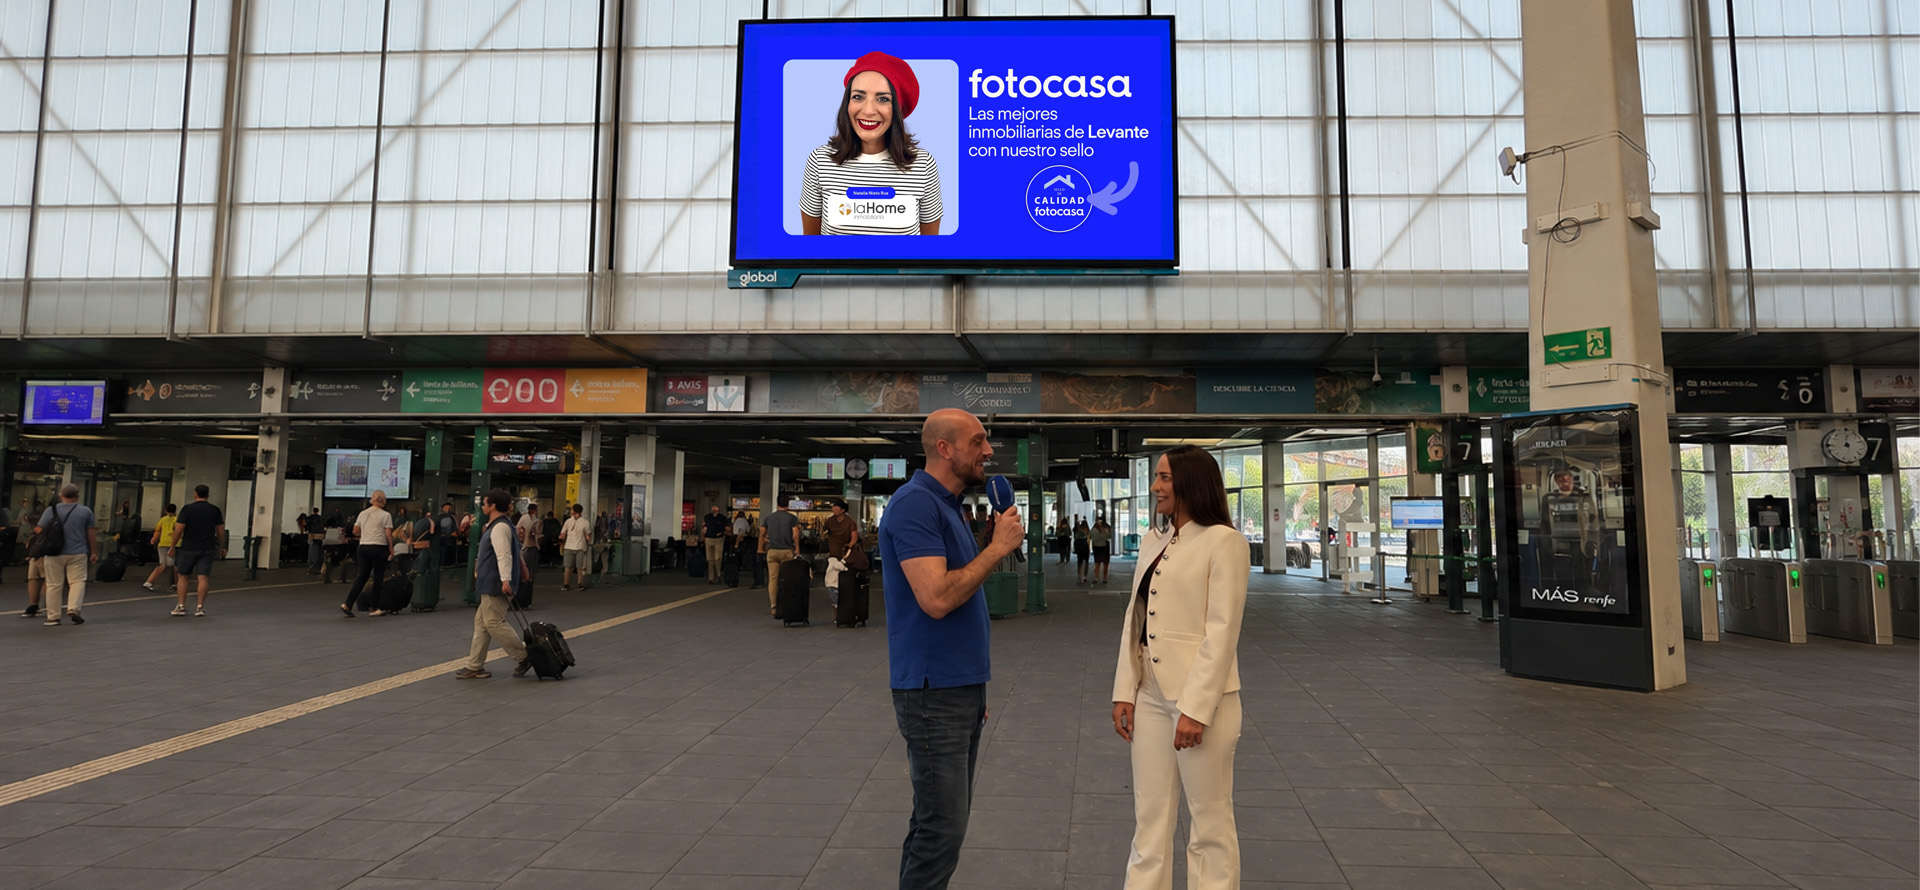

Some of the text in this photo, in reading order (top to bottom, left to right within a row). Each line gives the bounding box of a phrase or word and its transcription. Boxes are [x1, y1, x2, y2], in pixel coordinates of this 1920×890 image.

[969, 68, 1132, 98] fotocasa
[969, 107, 1058, 123] Las mejores
[969, 125, 1149, 138] inmobiliarias de Levante
[969, 143, 1095, 157] con nuestro sello
[854, 202, 906, 213] laHome
[1034, 207, 1084, 216] fotocasa
[740, 271, 777, 286] global
[677, 381, 701, 390] AVIS
[1457, 442, 1471, 460] 7
[1867, 437, 1882, 461] 7
[1532, 586, 1616, 607] MÁS renfe
